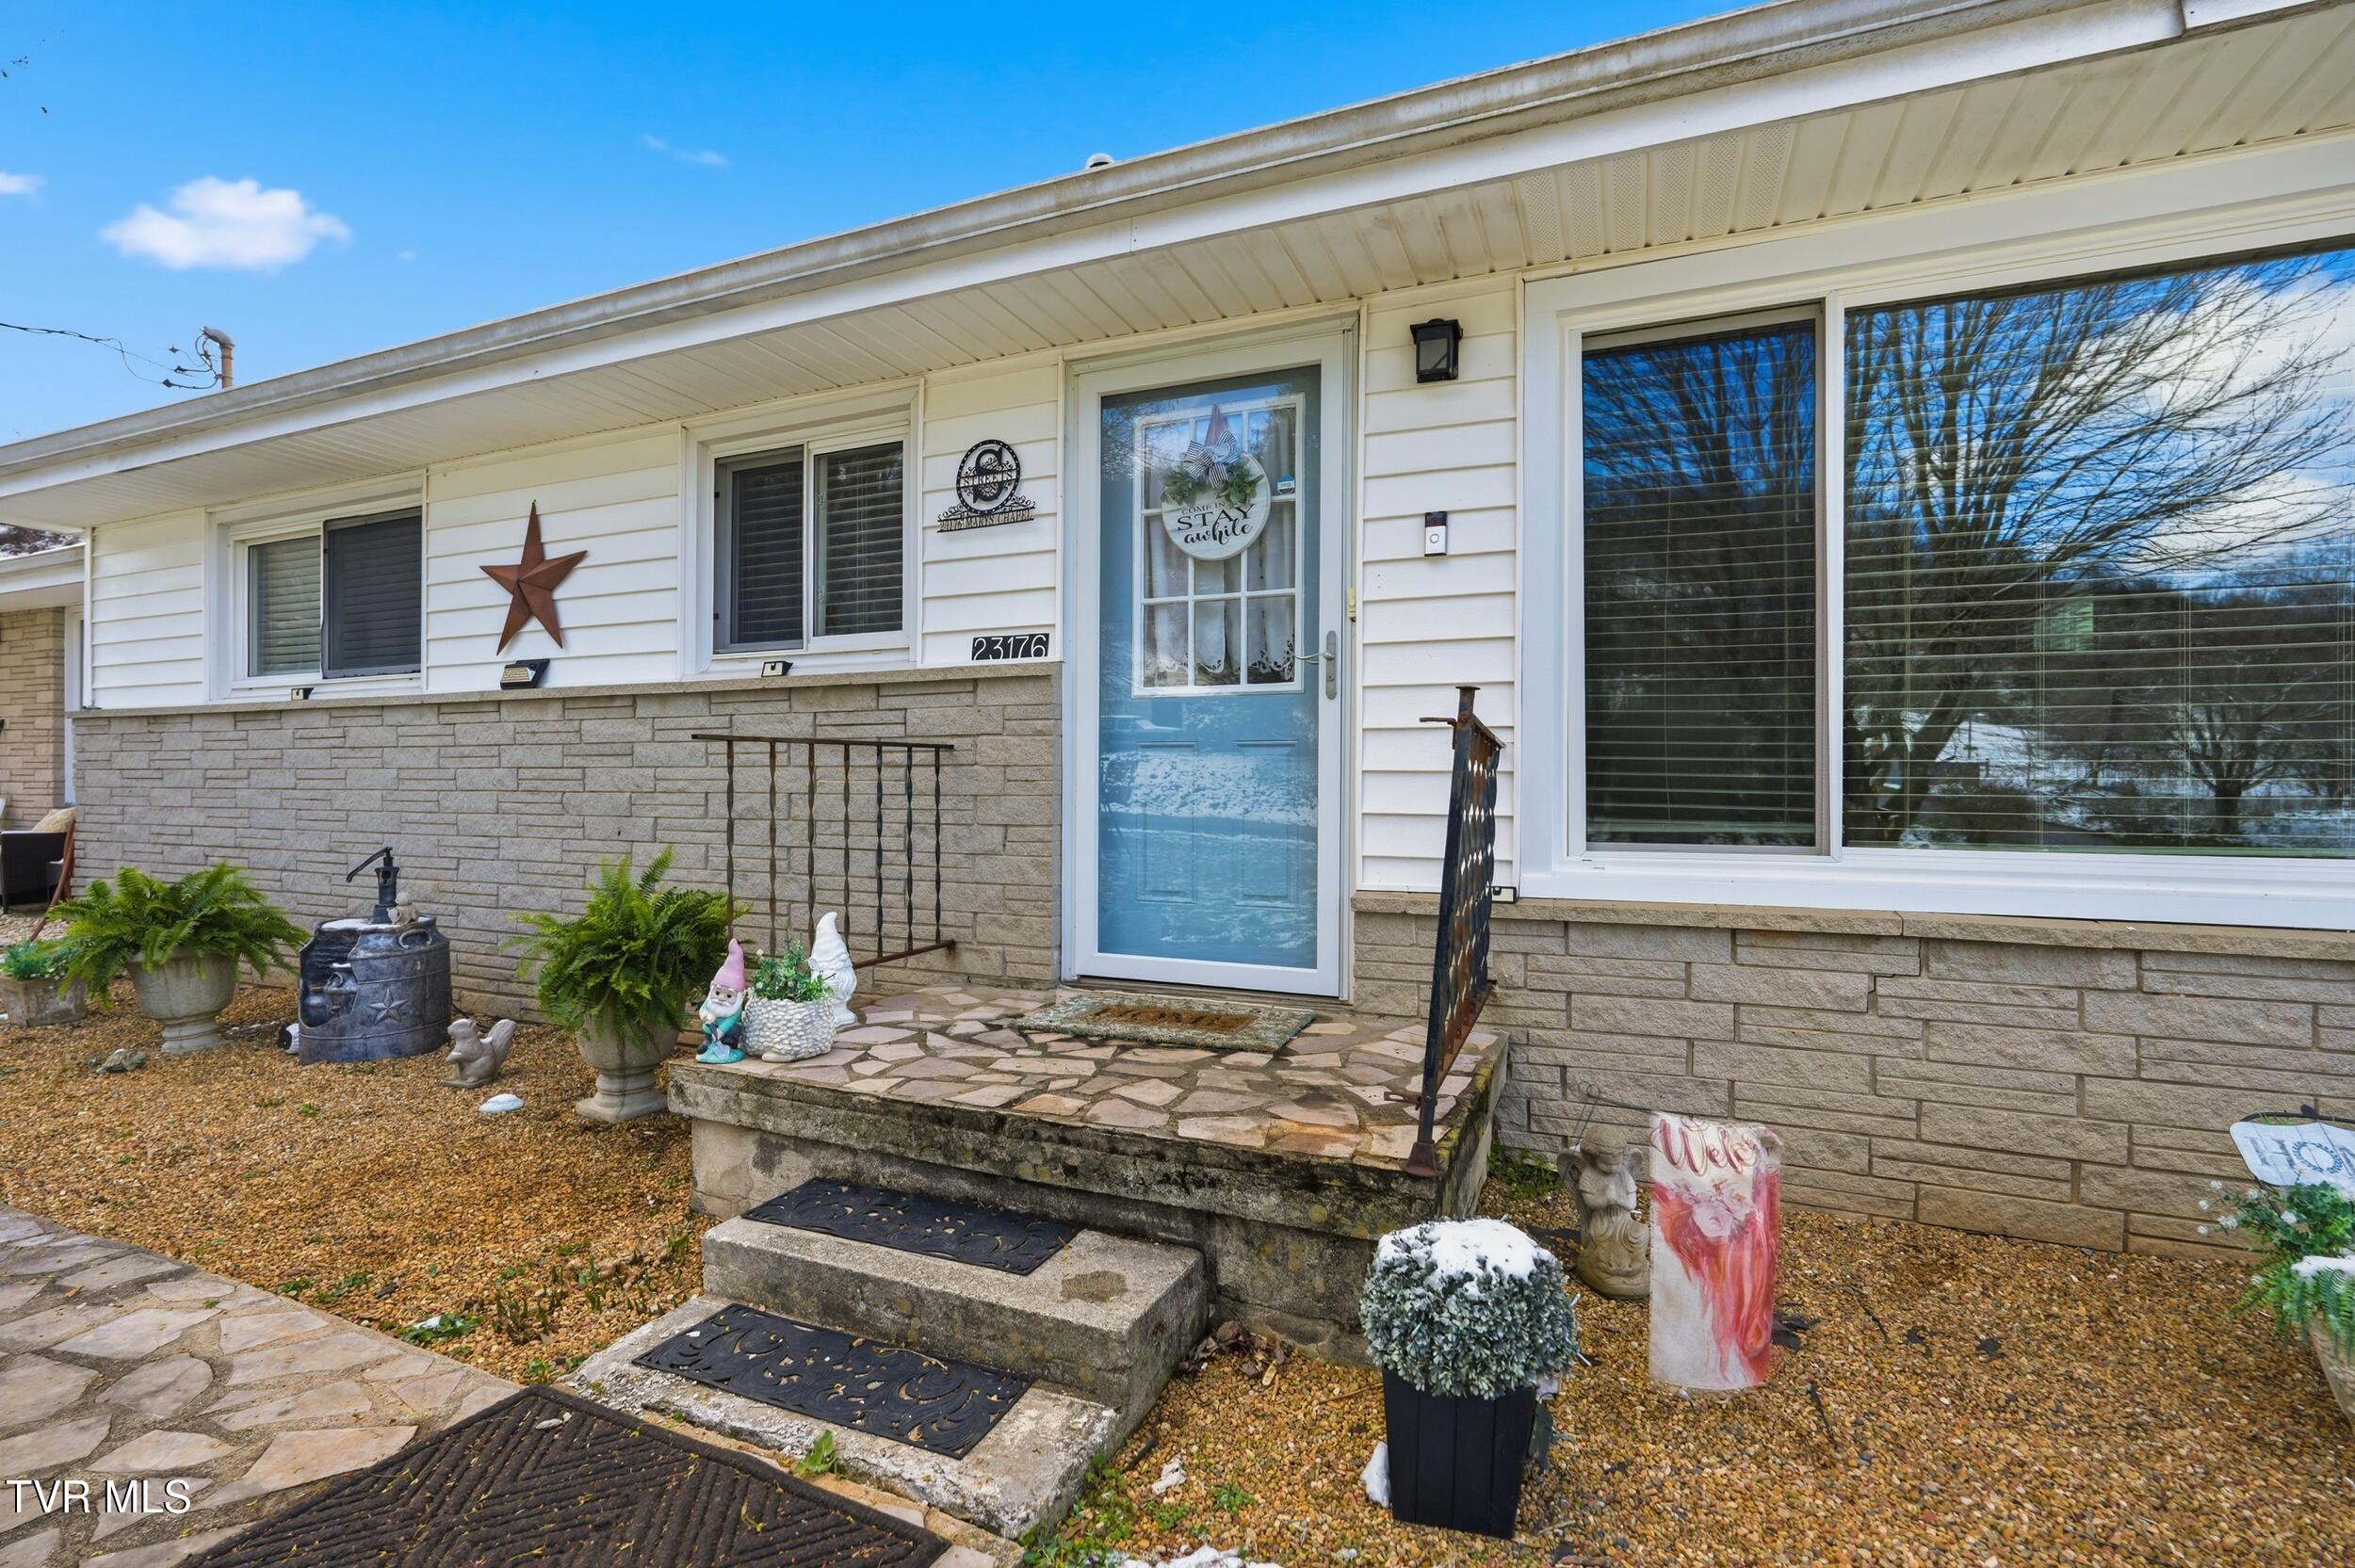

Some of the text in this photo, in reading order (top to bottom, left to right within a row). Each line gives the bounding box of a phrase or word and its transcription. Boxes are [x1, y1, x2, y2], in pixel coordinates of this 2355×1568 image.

[962, 473, 1014, 487] STREETS
[1178, 504, 1256, 530] STAY
[1184, 518, 1253, 545] awhile
[973, 634, 1047, 661] 23176
